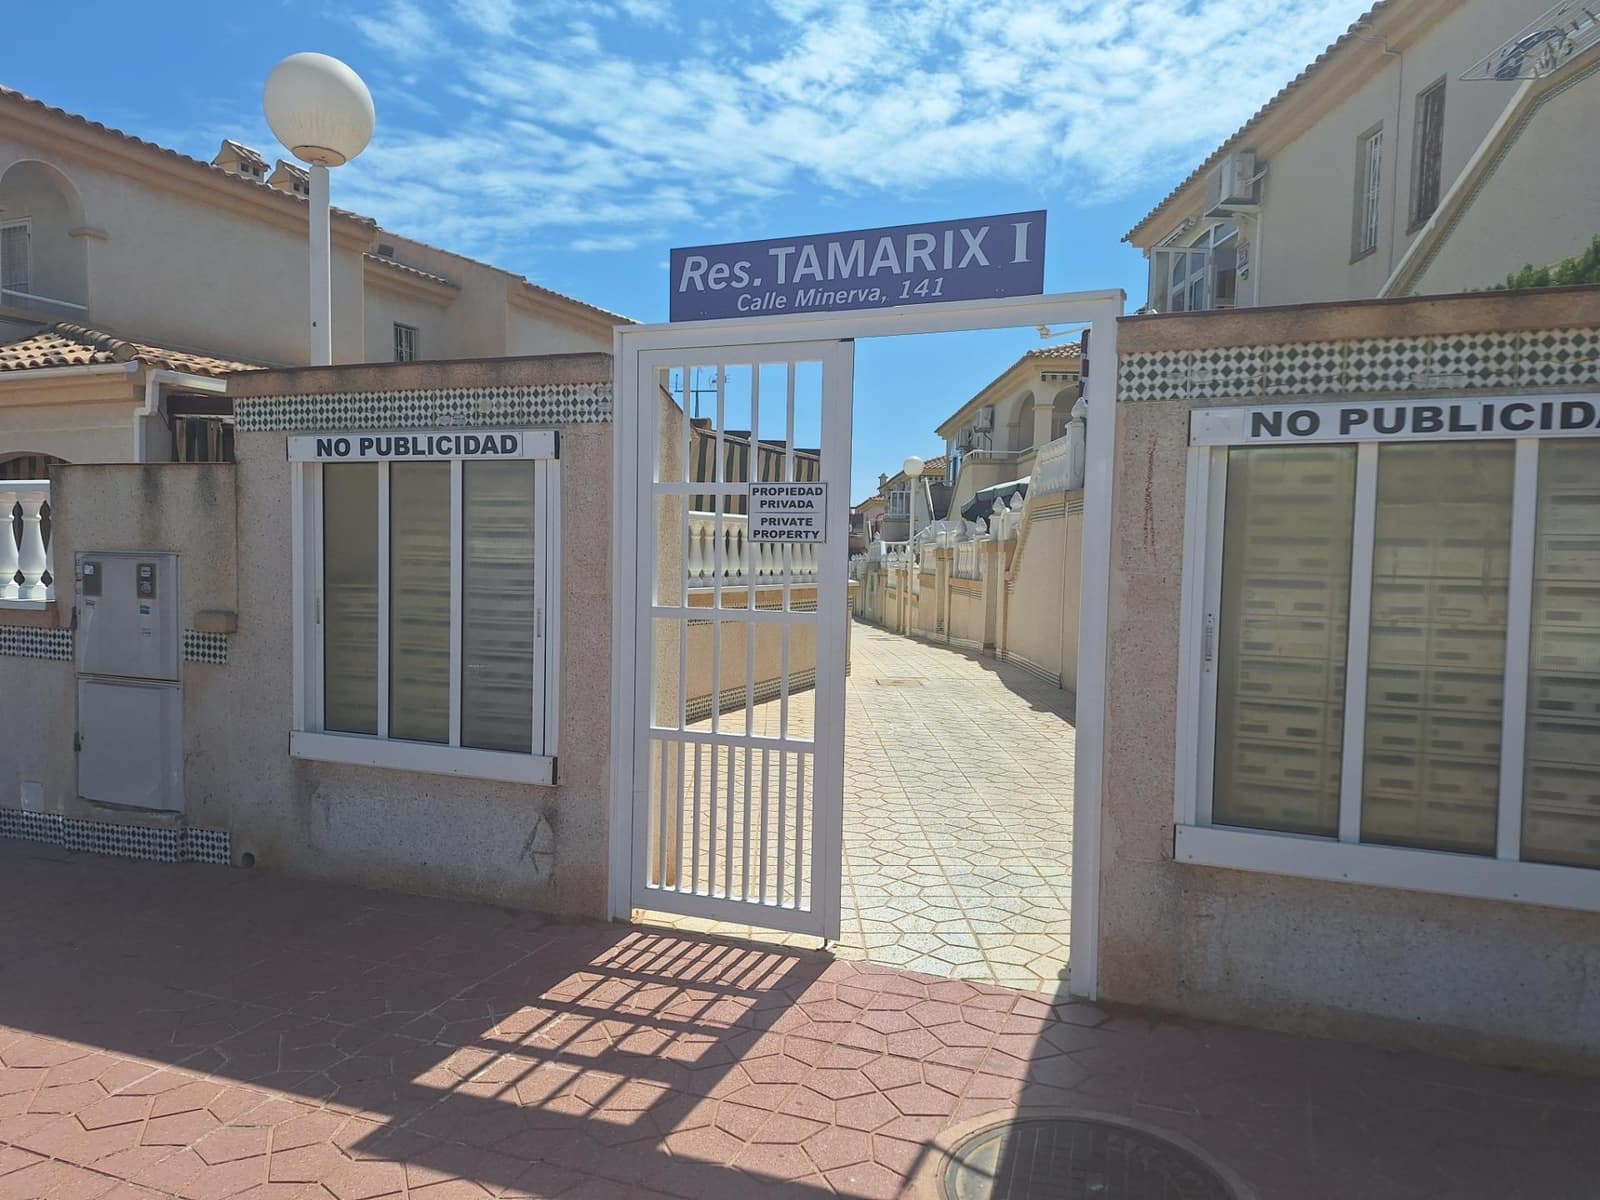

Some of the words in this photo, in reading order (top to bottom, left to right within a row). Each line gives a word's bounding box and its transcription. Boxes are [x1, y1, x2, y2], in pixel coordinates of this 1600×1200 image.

[679, 256, 762, 292] Res.
[768, 226, 990, 284] TAMARIX
[1009, 222, 1032, 263] I
[737, 291, 787, 312] Calle
[795, 287, 888, 307] Minerva,
[899, 277, 944, 298] 141
[1251, 410, 1321, 437] NO
[1339, 401, 1600, 435] PUBLICID
[316, 438, 350, 457] NO
[359, 435, 518, 456] PUBLICIDAD
[752, 487, 823, 496] PROPIEDAD
[760, 500, 814, 508] PRIVADA
[760, 518, 813, 527] PRIVATE
[753, 530, 819, 539] PROPERTY
